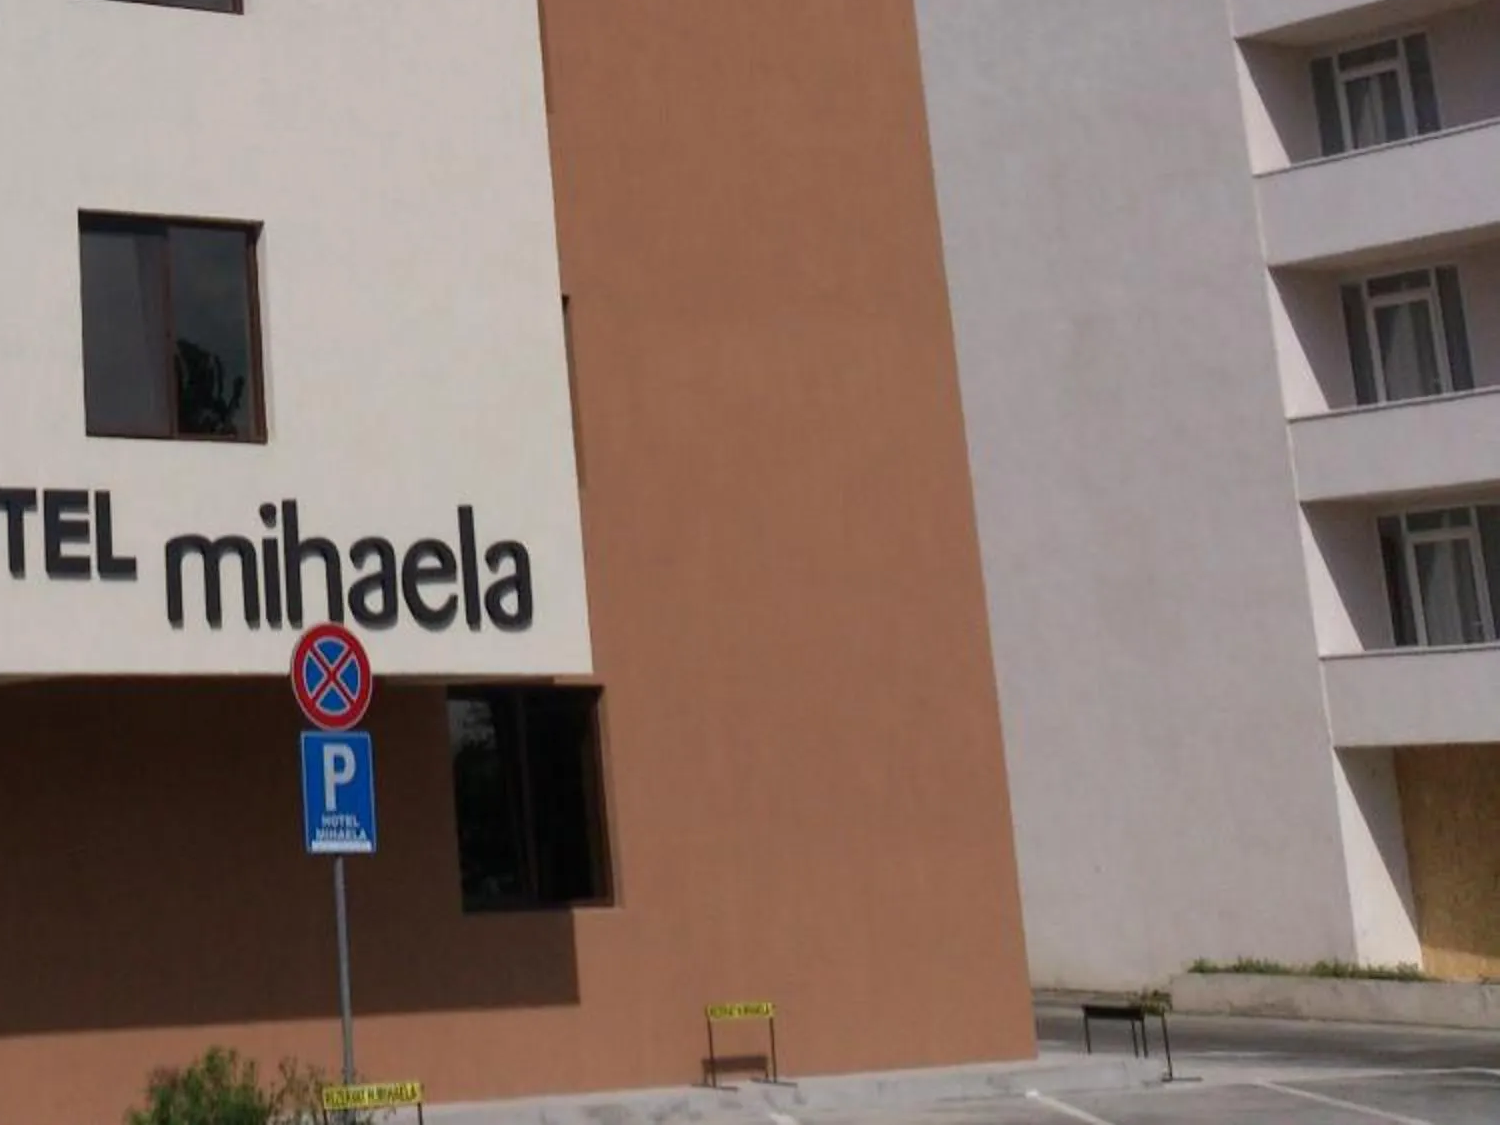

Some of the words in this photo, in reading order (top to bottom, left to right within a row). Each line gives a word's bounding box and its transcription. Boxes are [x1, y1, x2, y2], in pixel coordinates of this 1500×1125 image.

[164, 498, 533, 632] mihaela
[322, 742, 357, 812] P
[321, 813, 360, 828] HOTEL
